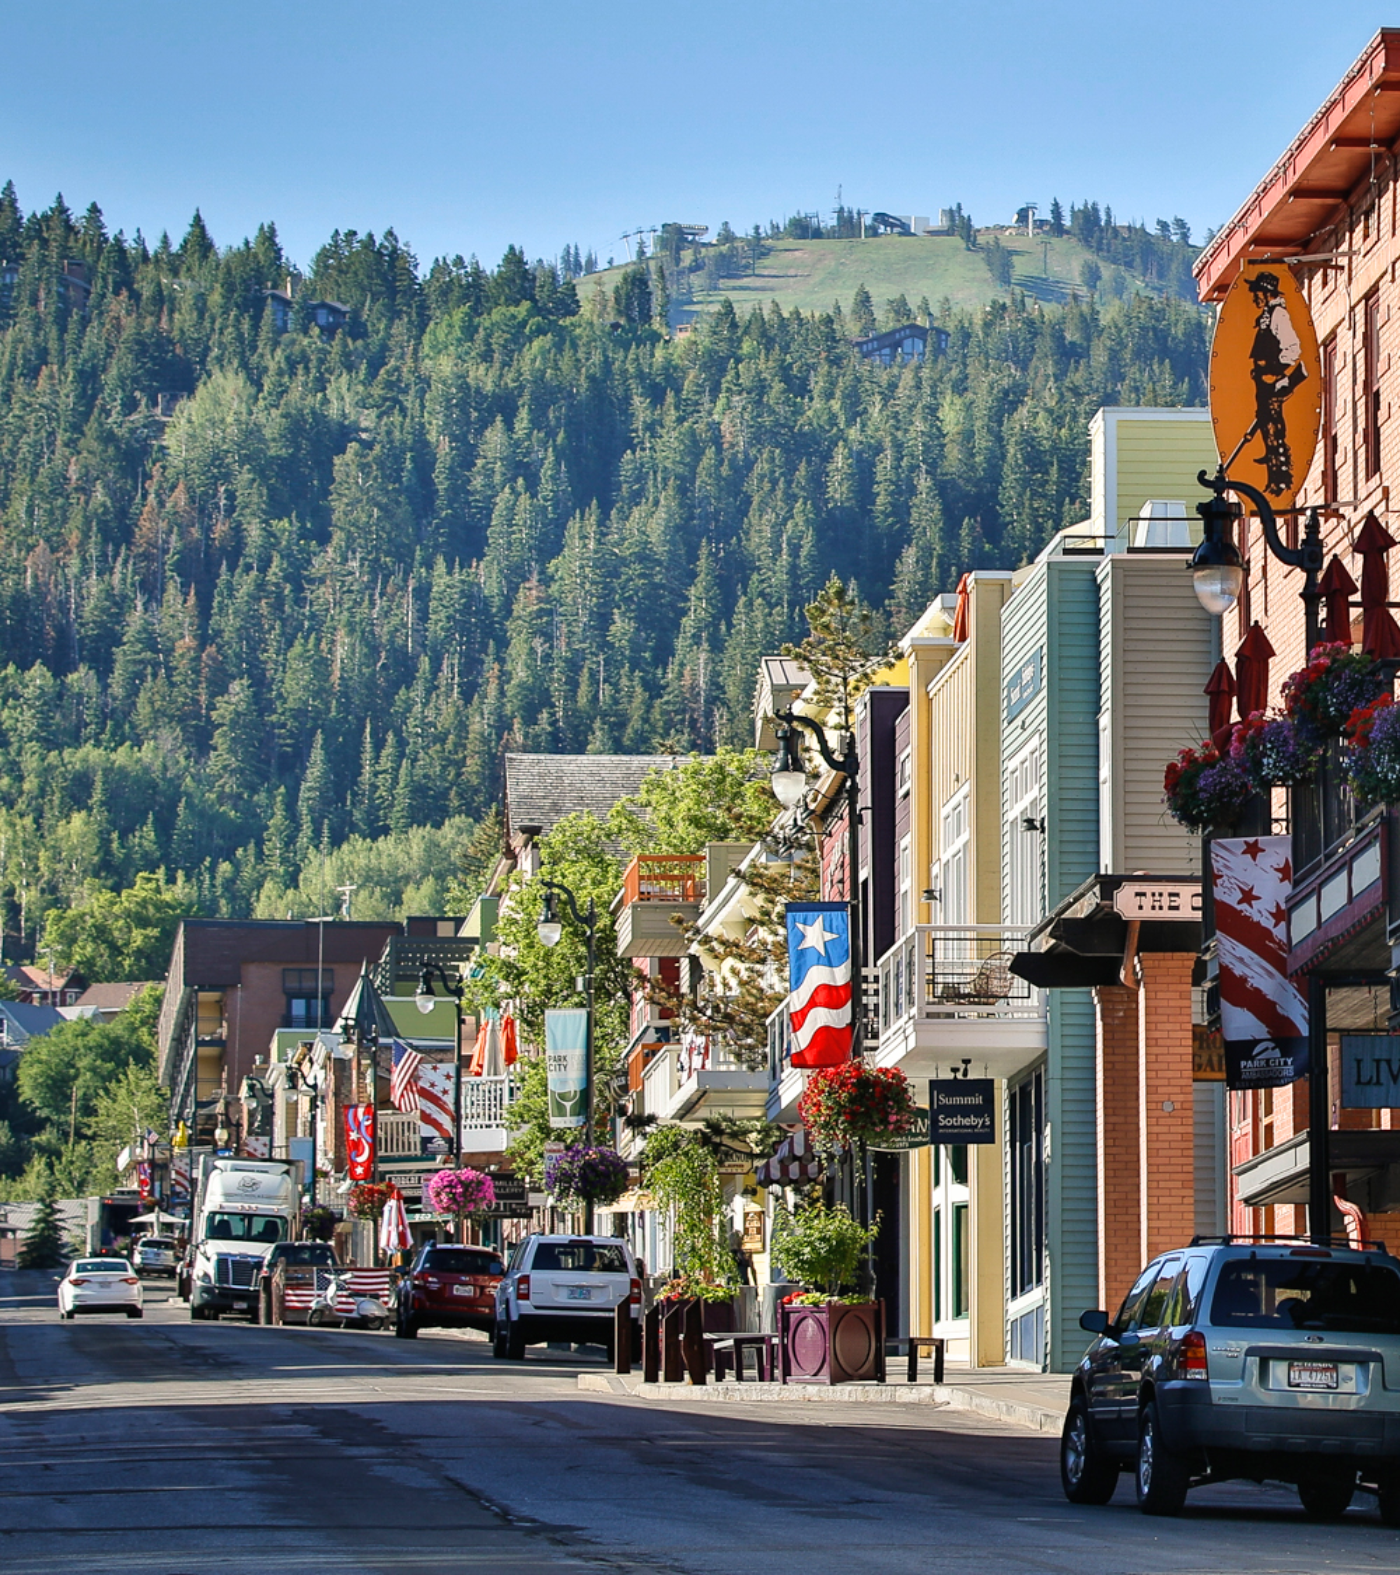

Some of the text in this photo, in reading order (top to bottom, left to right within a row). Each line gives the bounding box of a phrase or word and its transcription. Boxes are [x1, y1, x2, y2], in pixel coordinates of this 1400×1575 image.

[1134, 891, 1180, 911] THE
[548, 1054, 568, 1063] PARK
[1241, 1056, 1294, 1069] PARK CITY
[548, 1063, 568, 1072] CITY
[938, 1093, 983, 1105] Summit
[938, 1113, 990, 1128] Sotheby's
